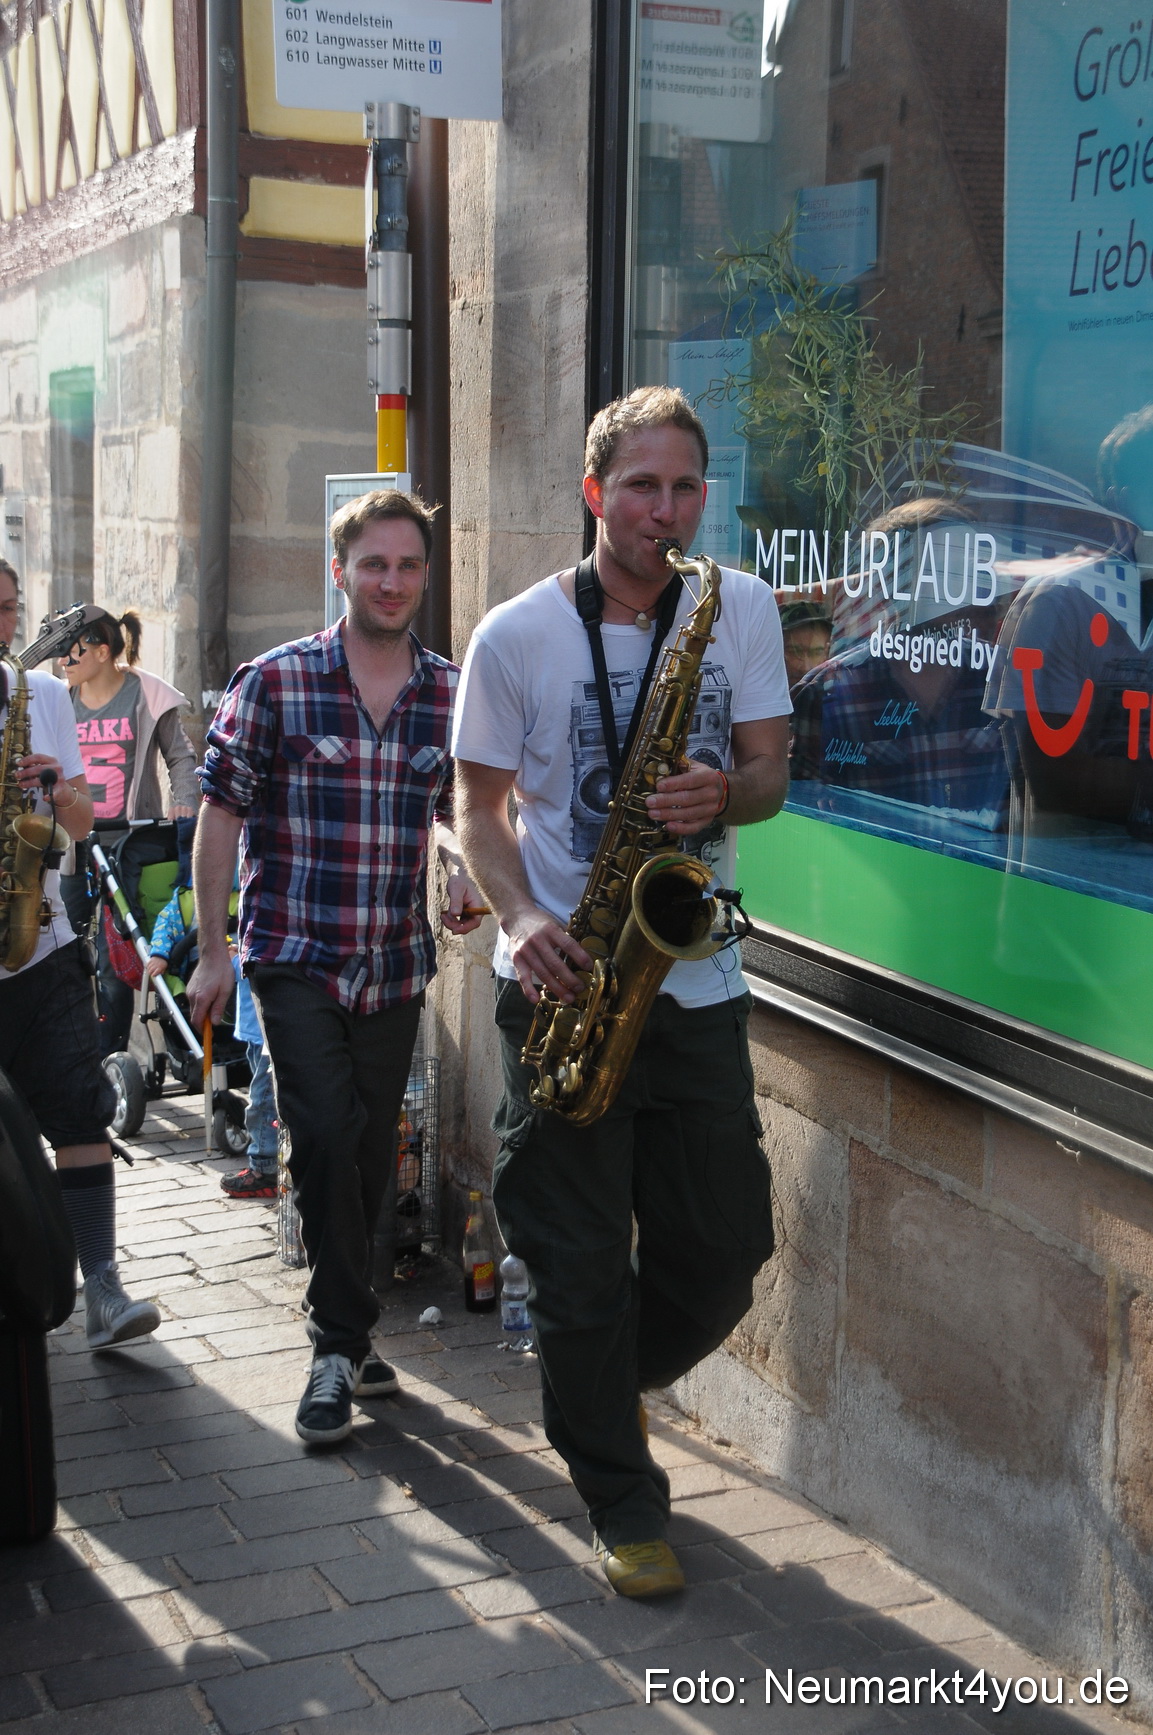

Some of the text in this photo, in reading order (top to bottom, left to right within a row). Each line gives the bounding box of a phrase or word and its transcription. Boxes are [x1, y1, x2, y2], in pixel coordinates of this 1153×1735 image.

[285, 8, 393, 29] 601 Wendelstein
[285, 30, 309, 44] 602
[315, 32, 388, 51] Langwasser
[392, 38, 425, 53] Mitte
[286, 50, 309, 63] 610
[316, 52, 388, 69] Langwasser
[393, 58, 426, 72] Mitte
[1068, 218, 1153, 297] Lieb
[756, 529, 997, 607] MEIN URLAUB
[870, 620, 999, 682] designed by
[1122, 689, 1153, 761] T
